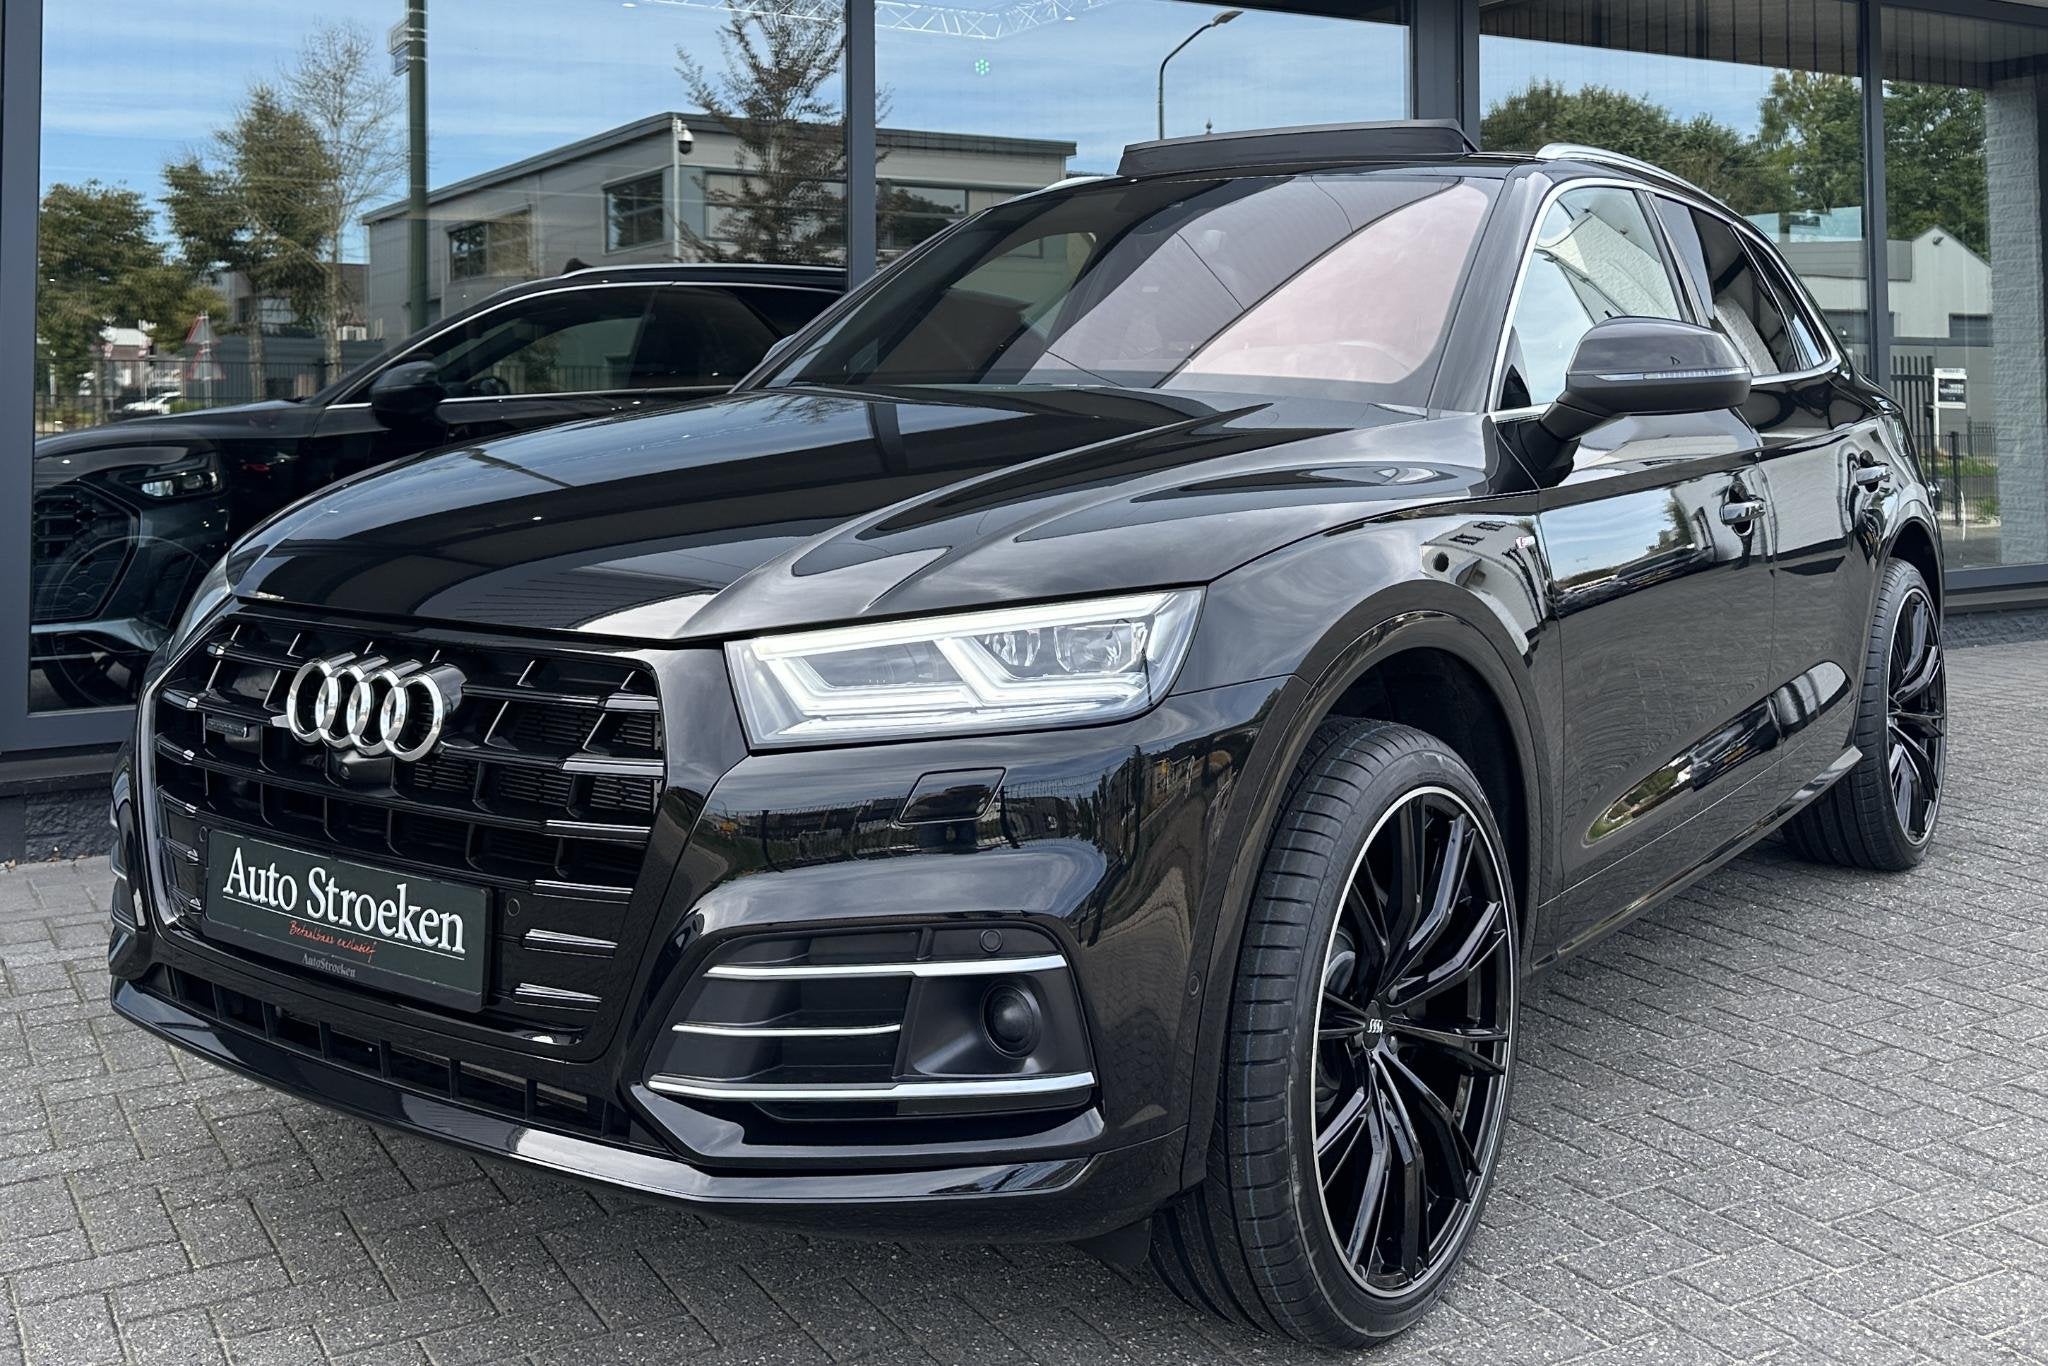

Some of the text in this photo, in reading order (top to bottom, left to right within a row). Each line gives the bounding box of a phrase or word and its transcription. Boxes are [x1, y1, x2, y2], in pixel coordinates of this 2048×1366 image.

[223, 847, 465, 953] Auto Stroeken
[302, 953, 356, 978] AutoStroeken
